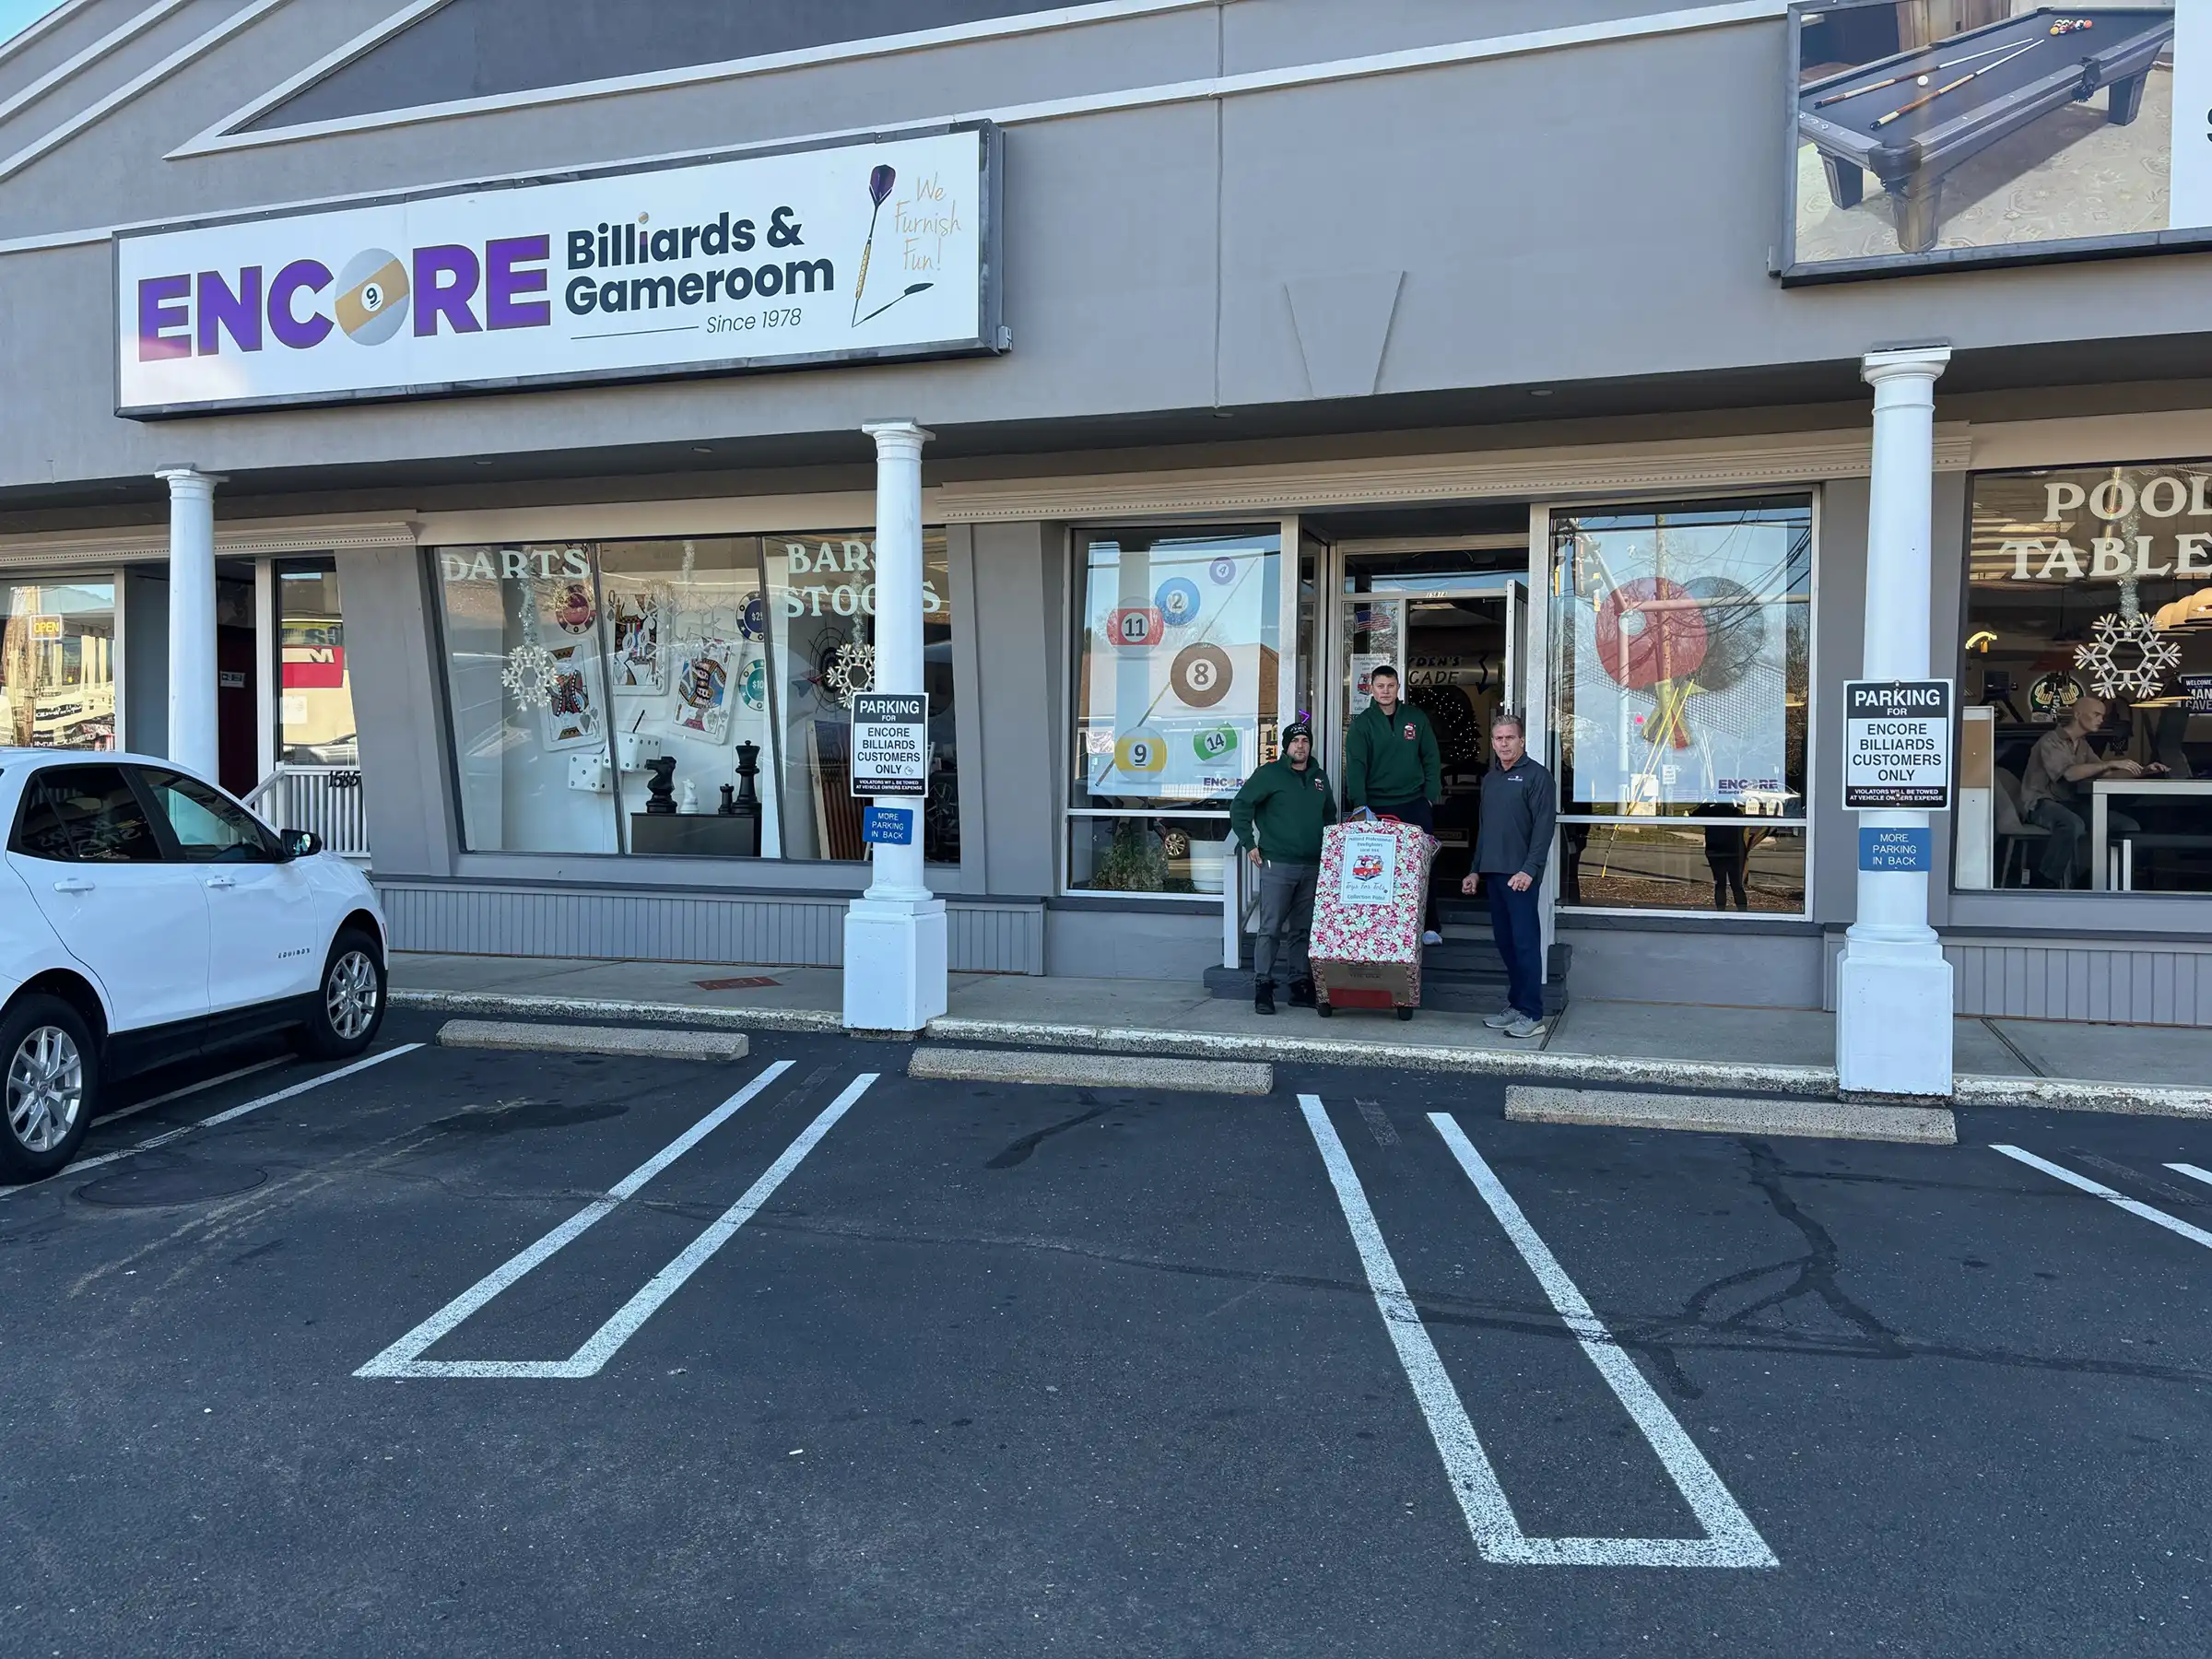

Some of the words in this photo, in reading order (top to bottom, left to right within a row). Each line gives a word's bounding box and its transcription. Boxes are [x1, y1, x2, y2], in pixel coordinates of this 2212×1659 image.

[917, 171, 947, 202] We
[894, 200, 961, 237] Furnish
[567, 211, 756, 270] Billiards
[767, 206, 805, 248] &
[903, 237, 942, 271] Fun!
[565, 258, 834, 315] Gameroom
[706, 314, 756, 334] Since
[762, 308, 802, 328] 1978
[2042, 476, 2212, 522] POOL
[1999, 532, 2212, 580] TABLE
[441, 548, 590, 582] DARTS
[1218, 565, 1228, 576] 4
[1171, 593, 1183, 610] 2
[34, 622, 59, 634] OPEN
[1124, 618, 1146, 637] 11
[1194, 663, 1209, 685] 8
[1854, 689, 1940, 707] PARKING
[860, 700, 920, 714] PARKING
[1887, 708, 1907, 716] FOR
[868, 727, 911, 737] ENCORE
[1867, 724, 1927, 735] ENCORE
[863, 739, 915, 749] BILLIARDS
[1206, 733, 1225, 751] 14
[1860, 738, 1935, 750] BILLIARDS
[857, 752, 921, 762] CUSTOMERS
[1135, 744, 1147, 767] 9
[1853, 754, 1942, 766] CUSTOMERS
[876, 764, 902, 774] ONLY
[329, 771, 360, 788] 1585
[1878, 770, 1915, 782] ONLY
[877, 813, 900, 821] MORE
[872, 821, 904, 830] PARKING
[883, 830, 903, 840] BACK
[1880, 833, 1909, 842] MORE
[1873, 845, 1917, 854] PARKING
[1873, 856, 1882, 865] IN
[1888, 856, 1916, 865] BACK
